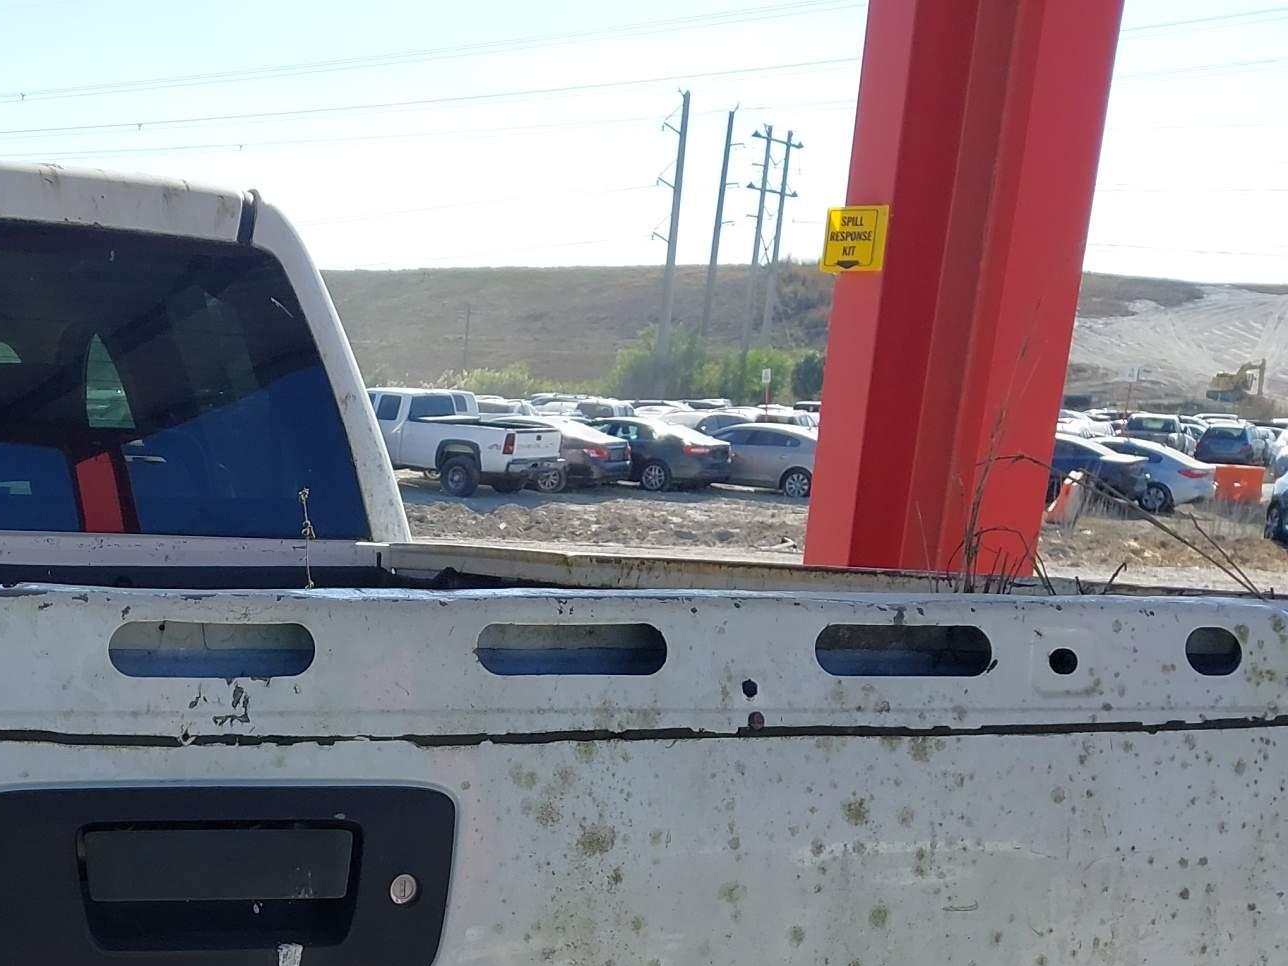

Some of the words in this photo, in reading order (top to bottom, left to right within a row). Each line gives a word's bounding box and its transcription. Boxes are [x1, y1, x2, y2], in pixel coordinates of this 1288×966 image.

[841, 216, 864, 227] SPILL
[830, 231, 872, 241] RESPONSE
[841, 247, 856, 257] KIT
